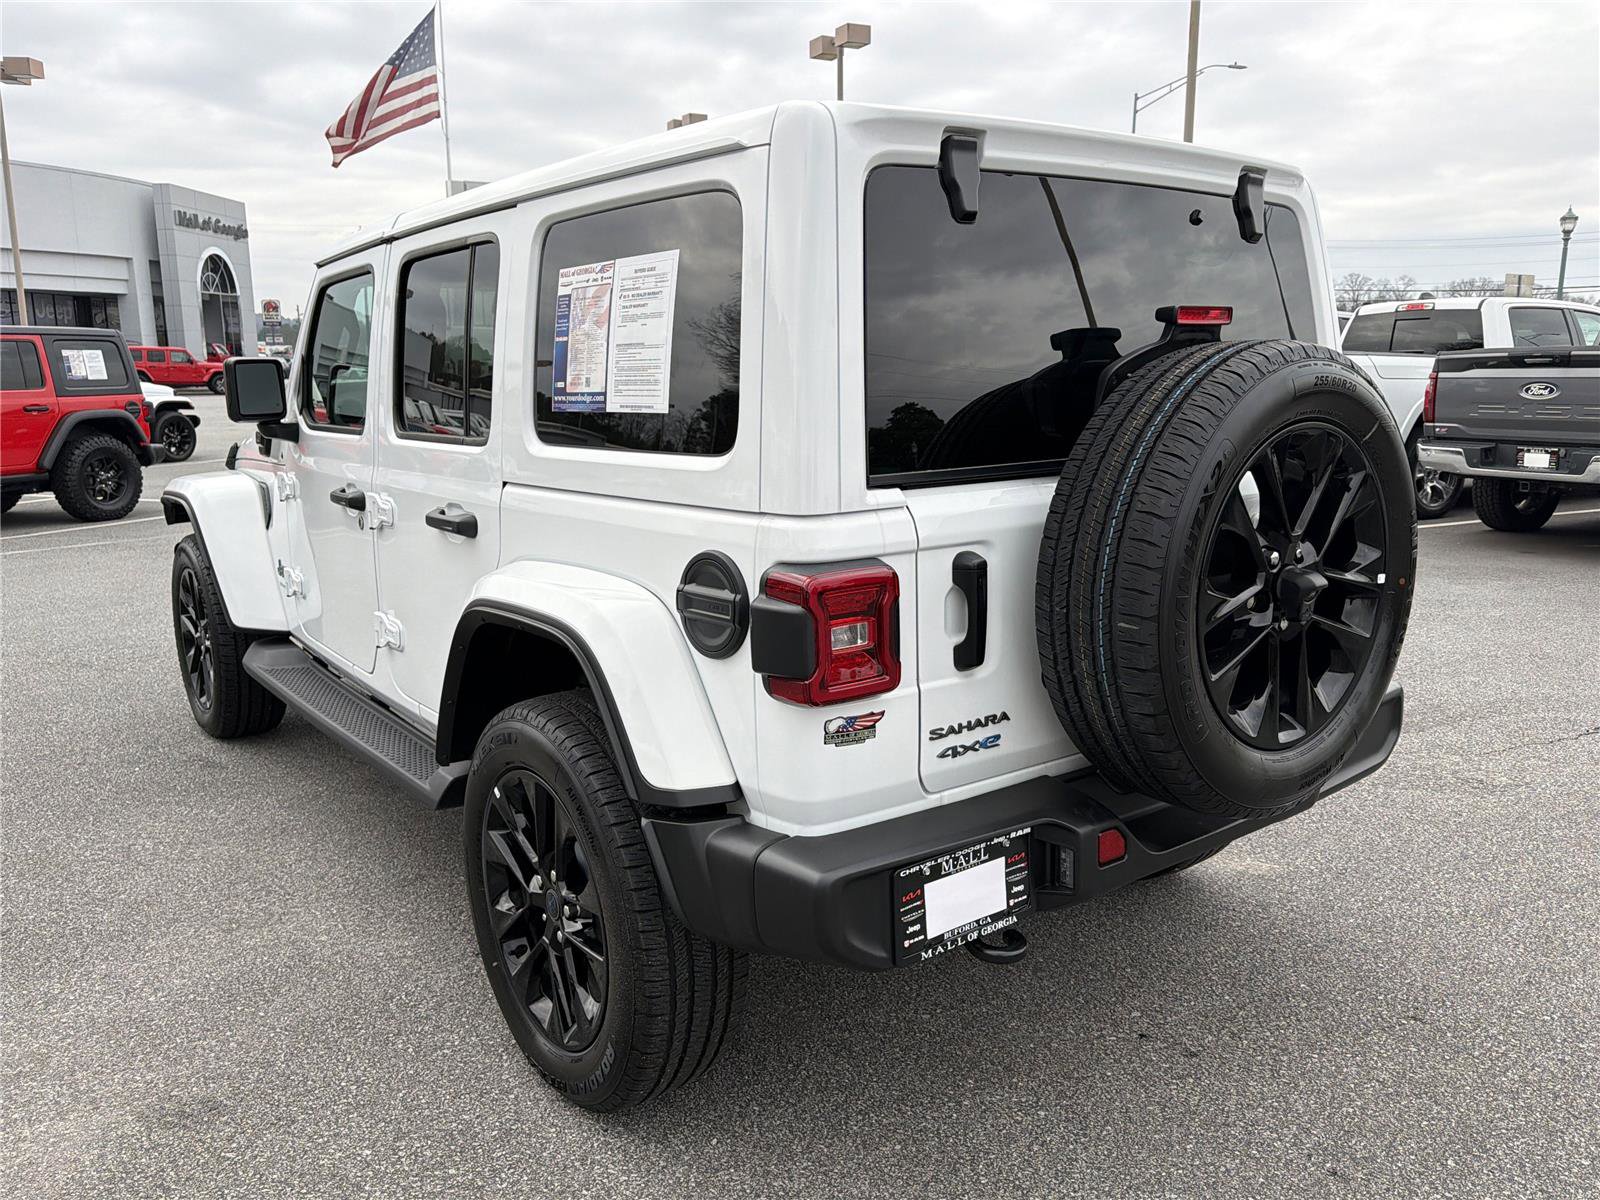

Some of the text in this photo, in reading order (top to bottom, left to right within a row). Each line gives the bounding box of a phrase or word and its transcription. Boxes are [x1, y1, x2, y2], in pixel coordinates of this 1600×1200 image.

[1313, 375, 1357, 393] 255/60R20
[1528, 385, 1551, 395] Ford
[929, 711, 1011, 741] SAHARA
[900, 855, 950, 877] CHRYSLER
[955, 842, 986, 857] DODGE
[991, 835, 1006, 845] Jeep
[1010, 828, 1031, 838] RAM
[1011, 884, 1024, 893] Jeep
[979, 916, 992, 925] GA
[906, 924, 921, 934] Jeep
[967, 931, 978, 942] OF
[981, 915, 1018, 936] GEORGIA
